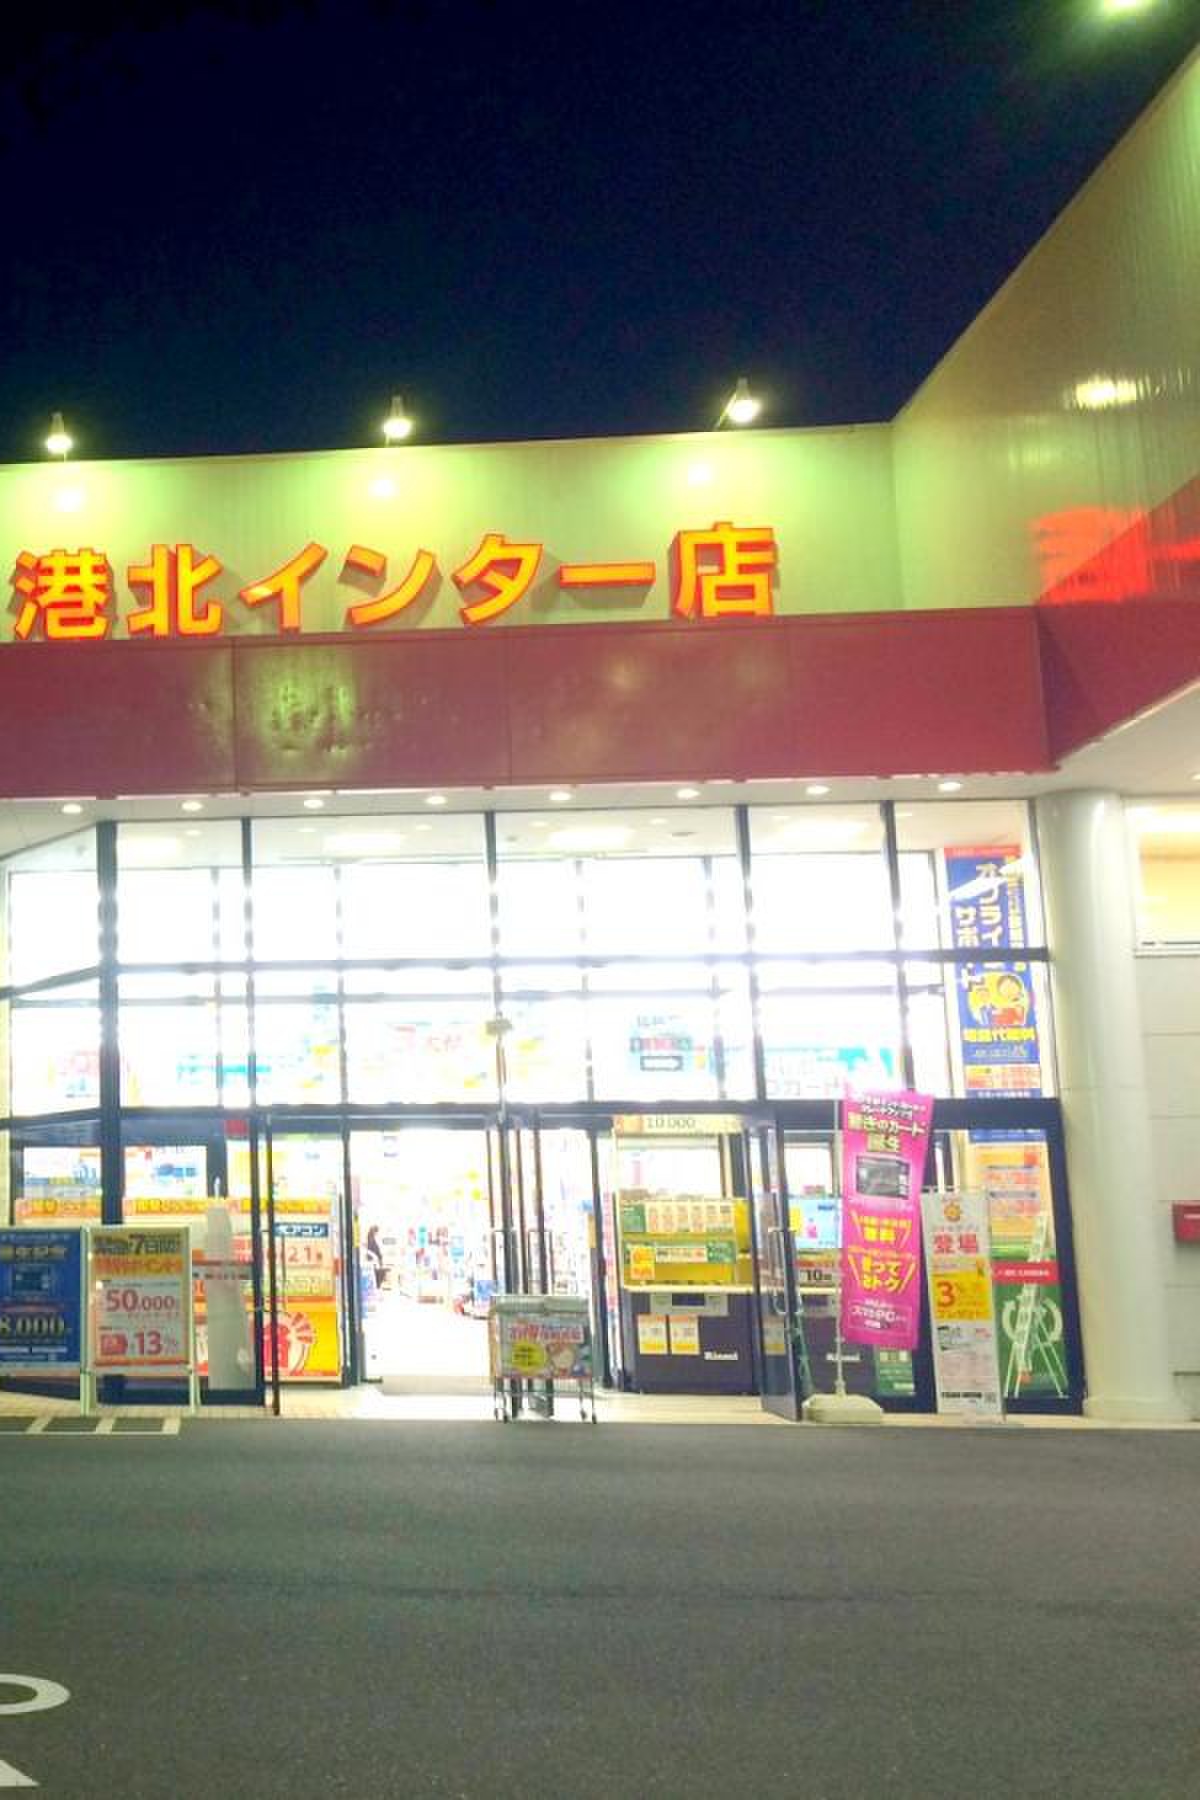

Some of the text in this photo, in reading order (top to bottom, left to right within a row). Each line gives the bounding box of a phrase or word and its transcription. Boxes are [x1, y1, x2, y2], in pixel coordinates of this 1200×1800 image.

[15, 521, 776, 641] 港北インター店
